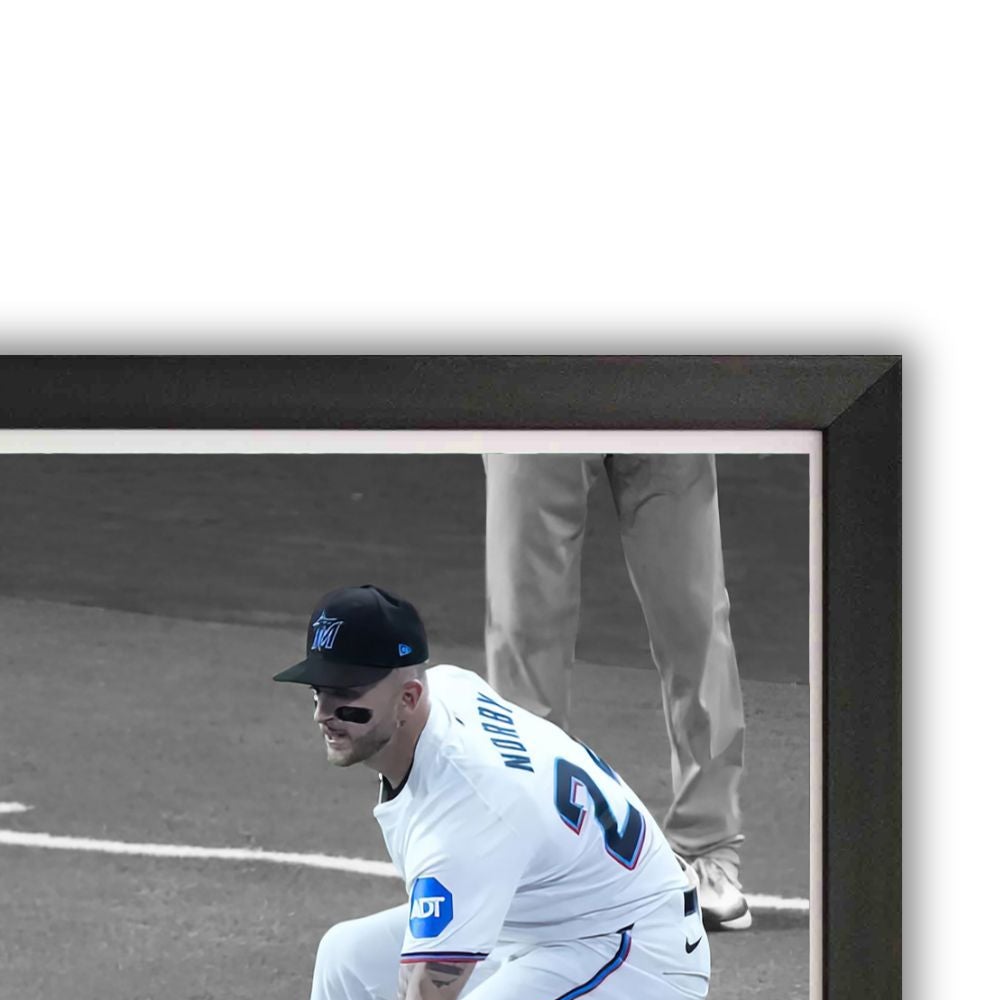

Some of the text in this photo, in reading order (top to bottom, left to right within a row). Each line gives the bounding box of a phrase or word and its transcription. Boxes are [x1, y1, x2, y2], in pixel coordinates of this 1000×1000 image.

[477, 692, 535, 773] NORBY
[554, 737, 646, 871] 2
[410, 896, 446, 919] ADT
